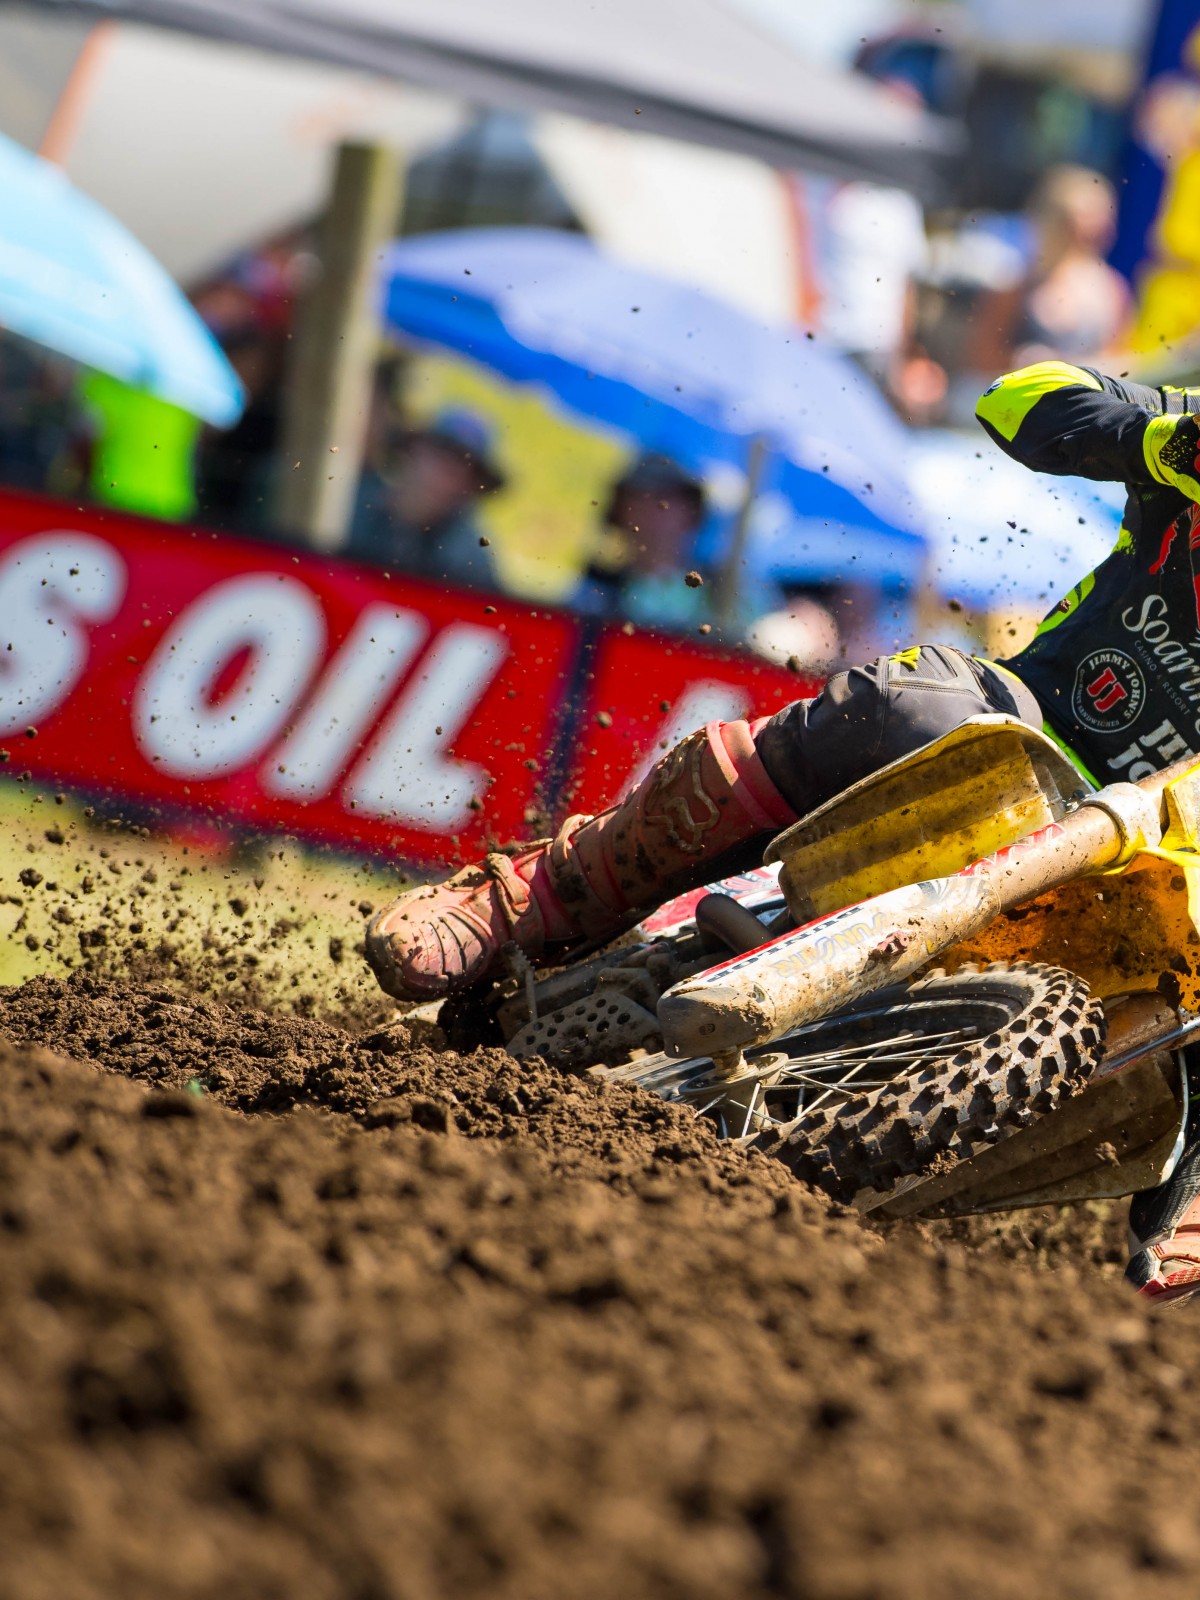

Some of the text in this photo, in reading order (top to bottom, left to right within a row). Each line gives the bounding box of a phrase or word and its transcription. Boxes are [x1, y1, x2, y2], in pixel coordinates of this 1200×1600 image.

[131, 569, 510, 836] OIL
[1089, 653, 1141, 719] JIMMY JOHN'S
[1134, 639, 1157, 672] CASINO
[1162, 680, 1190, 716] RESORT
[707, 906, 864, 983] DUNLOP
